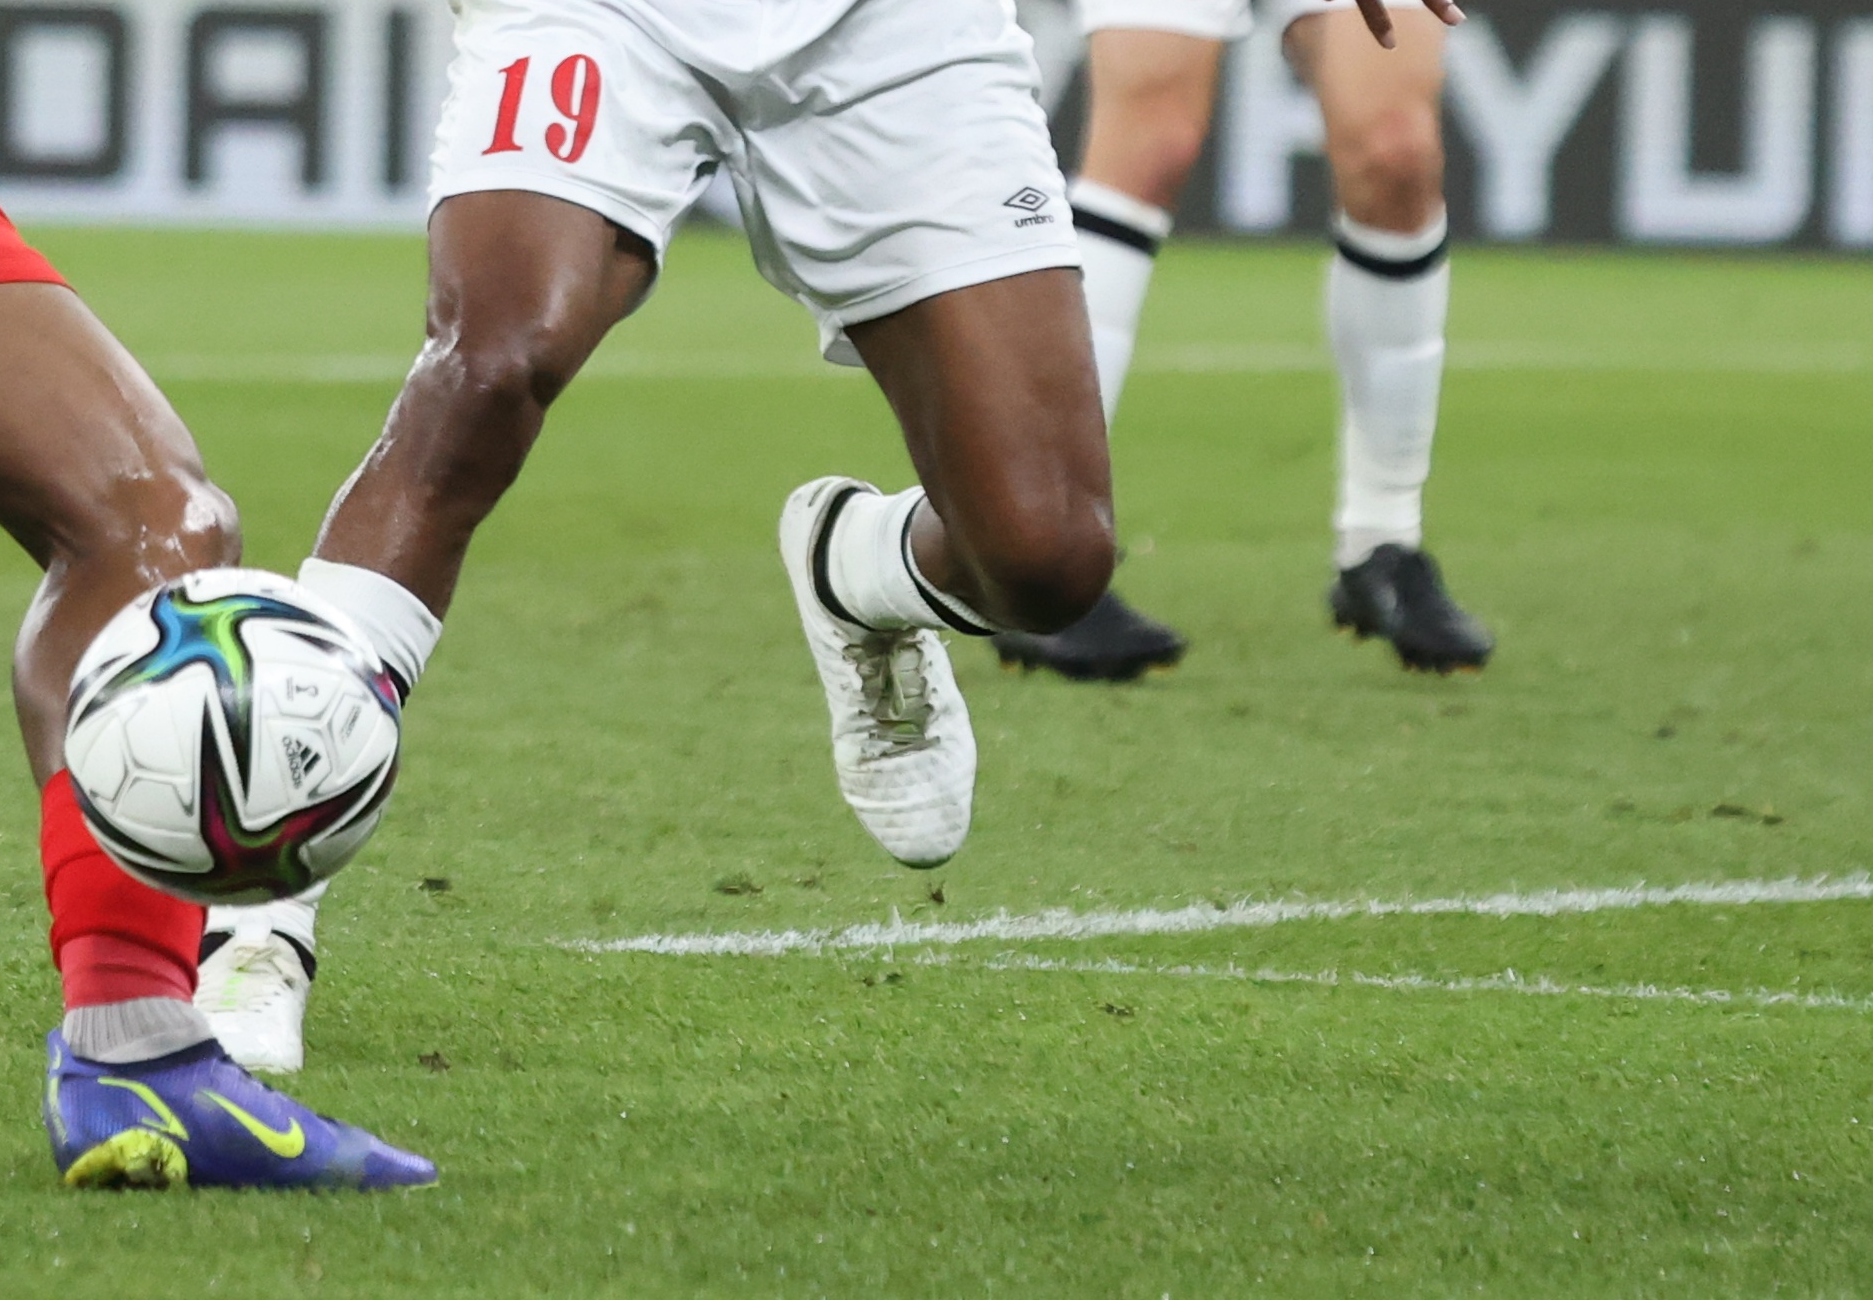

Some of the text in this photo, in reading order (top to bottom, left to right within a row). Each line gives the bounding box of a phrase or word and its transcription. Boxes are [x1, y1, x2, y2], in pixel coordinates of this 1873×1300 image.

[481, 53, 602, 164] 19
[1014, 213, 1055, 228] umbro
[282, 735, 302, 790] adidas
